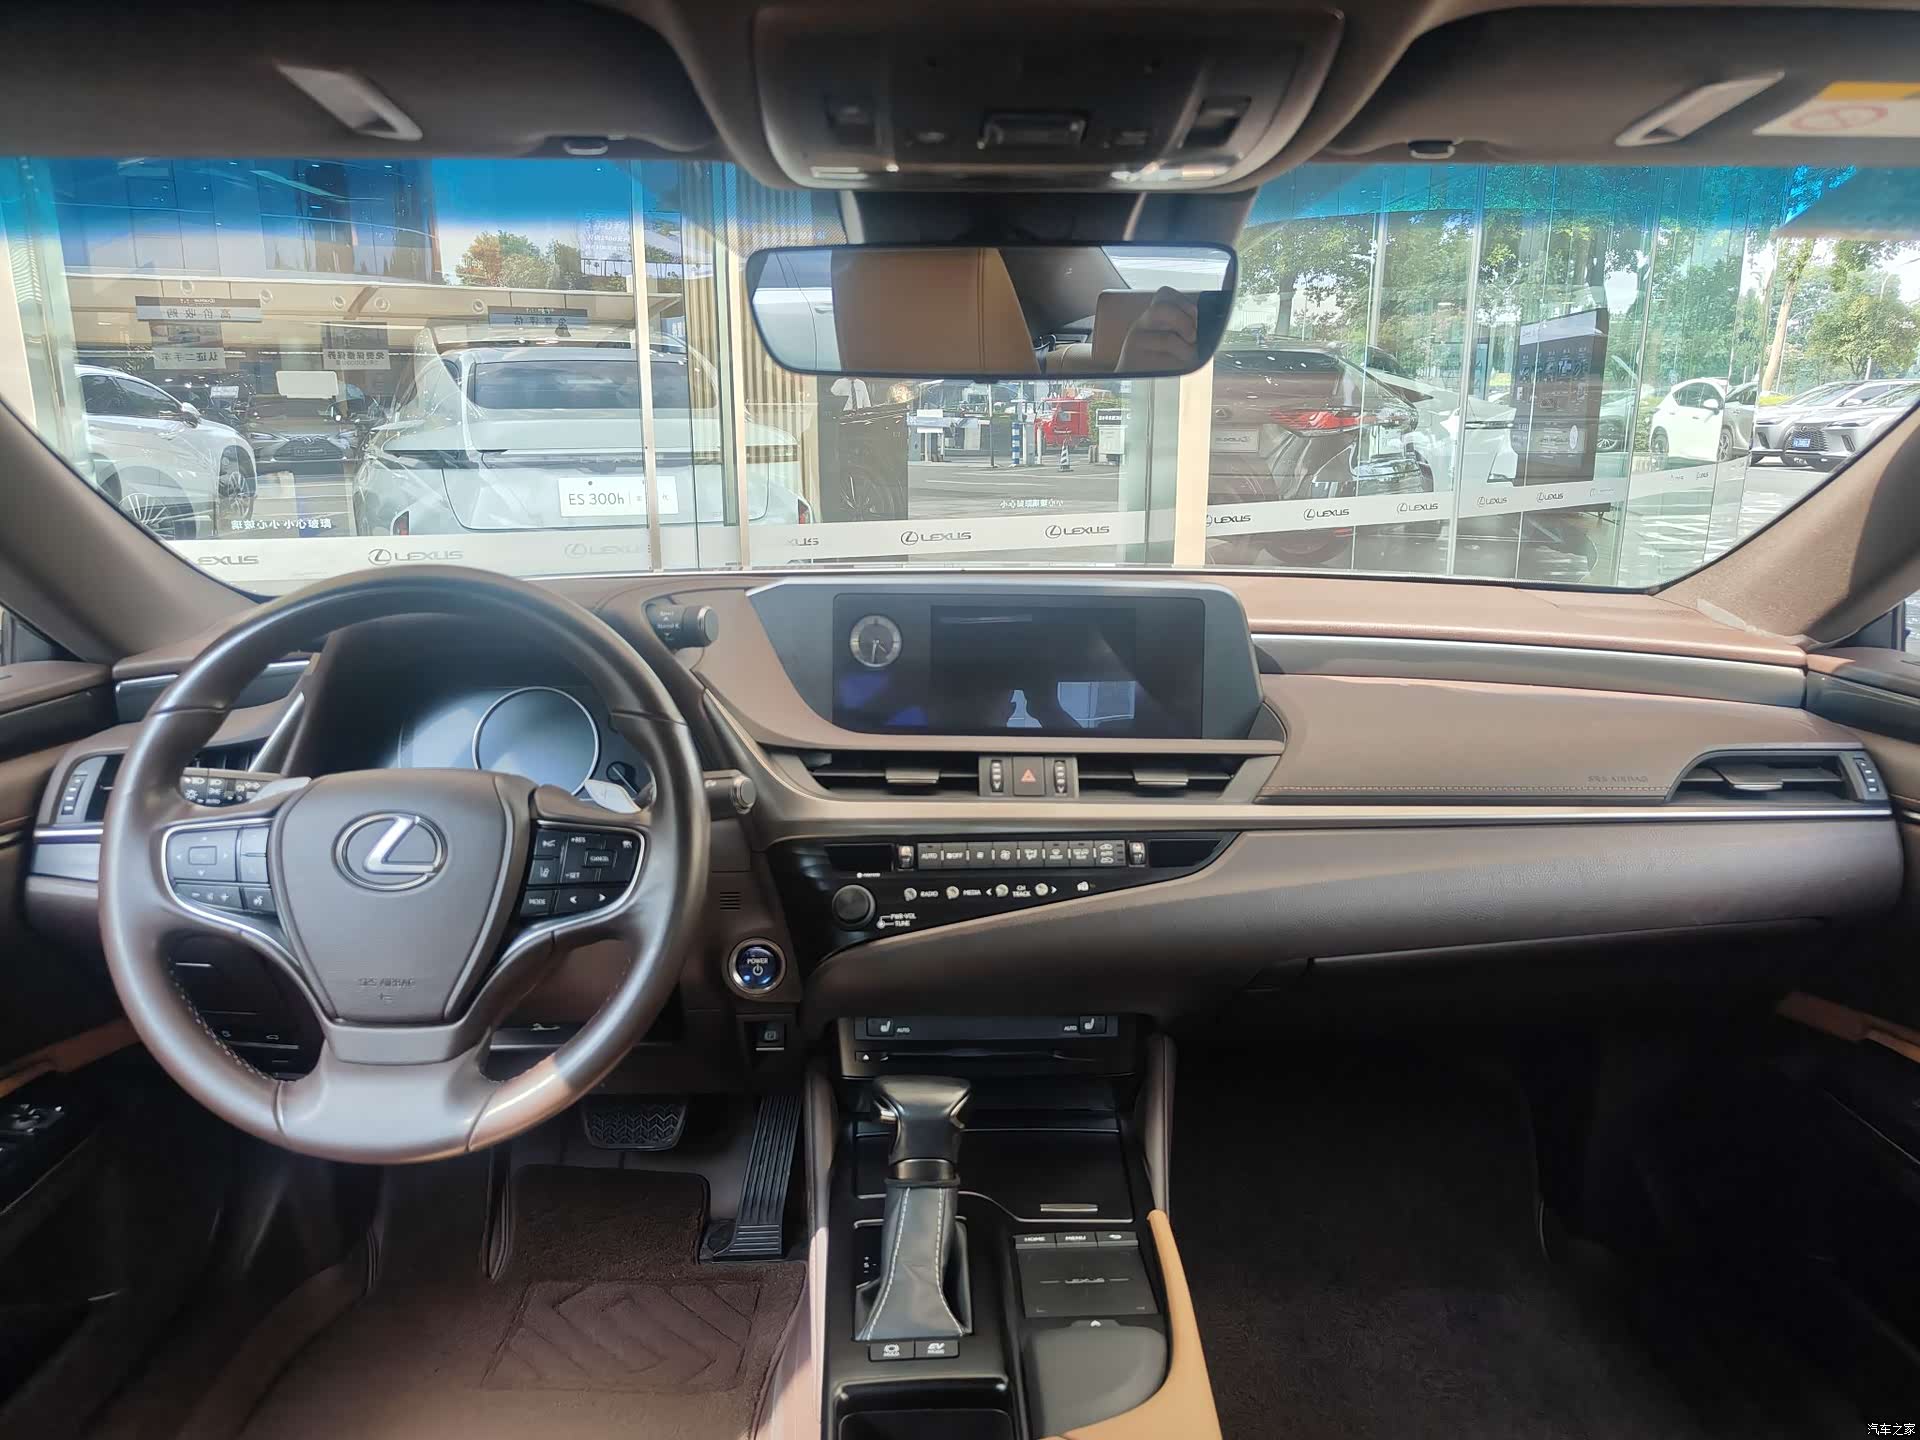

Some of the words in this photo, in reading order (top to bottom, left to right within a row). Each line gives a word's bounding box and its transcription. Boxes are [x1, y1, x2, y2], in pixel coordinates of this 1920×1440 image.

[568, 494, 585, 505] ES
[592, 492, 624, 505] 300h
[1408, 503, 1439, 511] LEXUS
[1316, 508, 1350, 518] LEXUS
[1214, 514, 1251, 524] LEXUS
[1063, 526, 1110, 535] LEXUS
[920, 532, 972, 541] LEXUS
[395, 550, 464, 561] LEXUS
[198, 555, 259, 566] EXUS
[920, 890, 939, 898] RADIO
[747, 957, 769, 965] POWER
